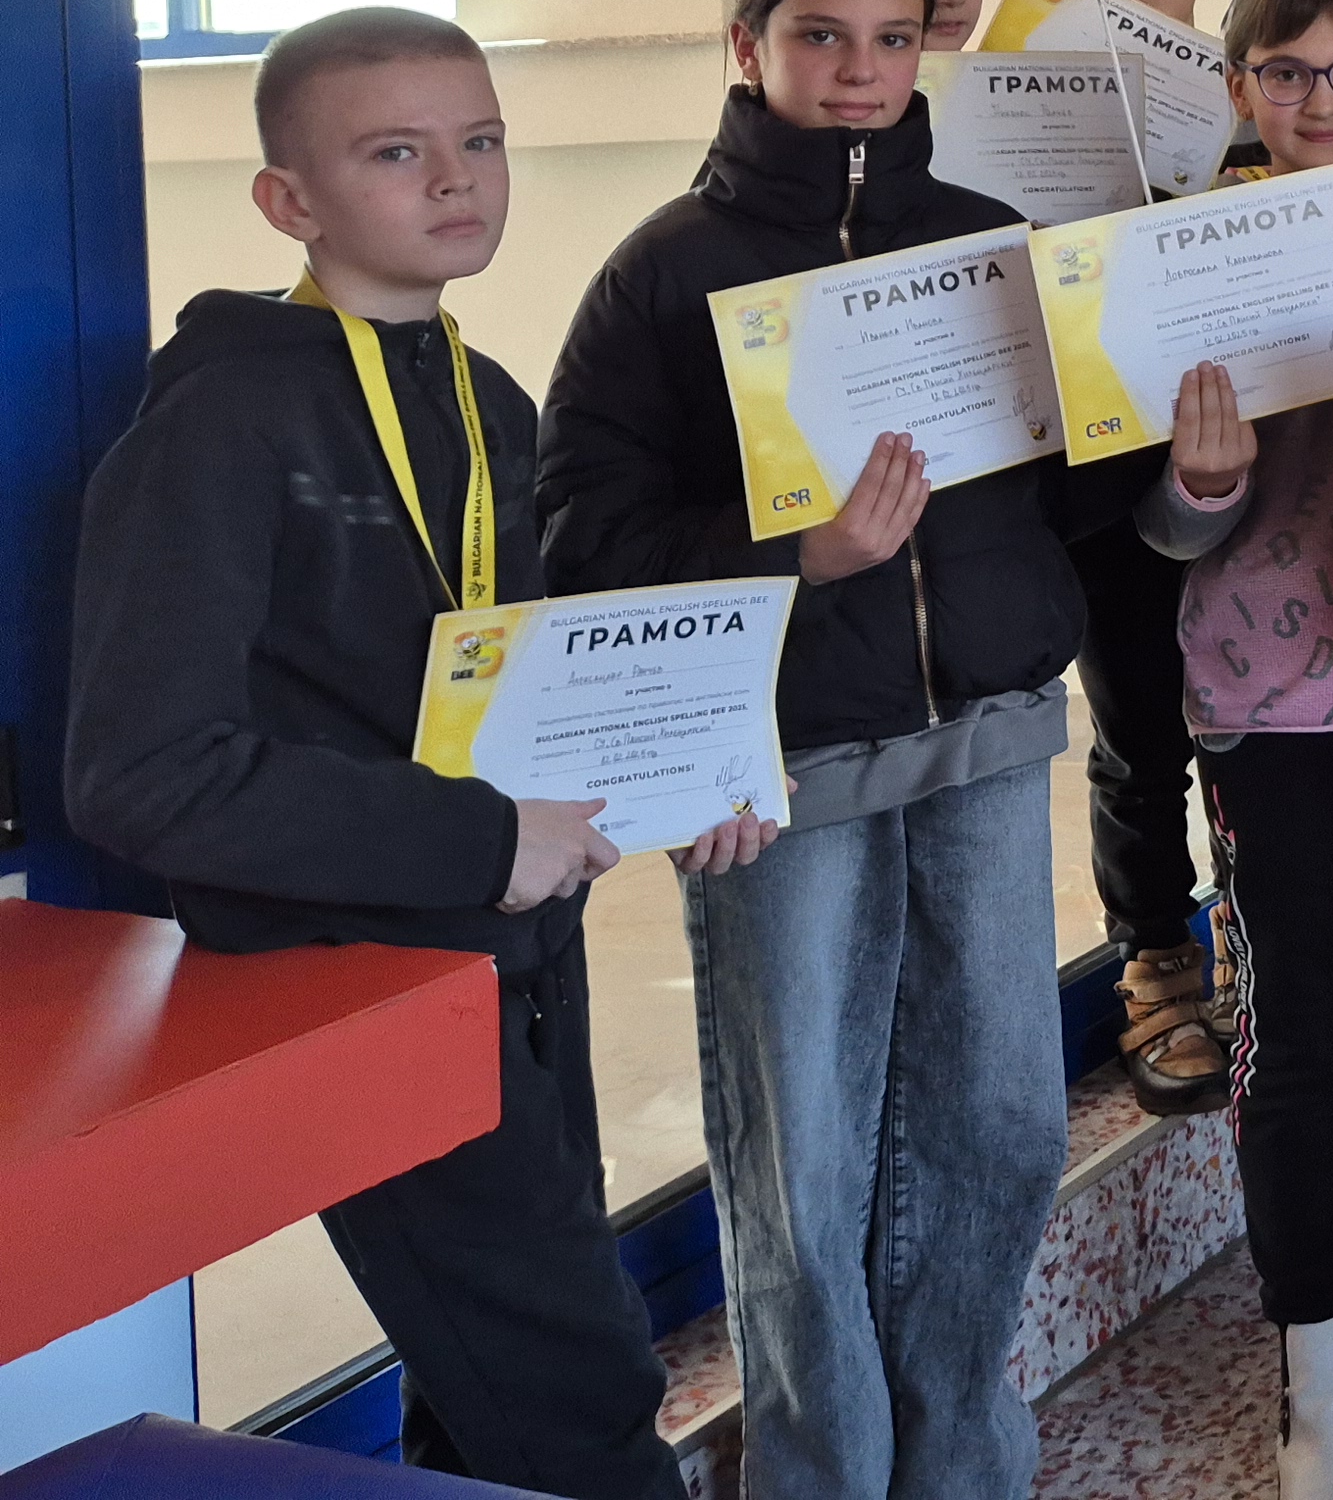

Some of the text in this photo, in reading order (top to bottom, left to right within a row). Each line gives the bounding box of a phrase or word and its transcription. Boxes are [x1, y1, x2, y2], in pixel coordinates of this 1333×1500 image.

[1107, 10, 1224, 76] ГРАМОТА
[989, 76, 1119, 93] ГРАМОТА
[1136, 217, 1186, 234] BULGARIAN
[1188, 206, 1233, 221] NATIONAL
[1156, 199, 1324, 255] ГРАМОТА
[822, 278, 872, 295] BULGARIAN
[874, 268, 917, 283] NATIONAL
[919, 258, 956, 273] ENGLISH
[843, 261, 1005, 316] ГРАМОТА
[1156, 314, 1200, 330] BULGARIAN
[1202, 304, 1240, 319] NATIONAL
[1242, 296, 1275, 309] ENGLISH
[1277, 287, 1313, 300] SPELLING
[1213, 333, 1310, 363] CONGRATULATIONS!
[892, 369, 929, 384] NATIONAL
[931, 360, 961, 374] ENGLISH
[963, 351, 997, 364] SPELLING
[905, 398, 996, 430] CONGRATULATIONS!
[473, 514, 482, 577] BULGARIAN
[550, 595, 769, 628] BULGARIAN NATIONAL ENGLISH SPELLING BEE
[566, 611, 745, 654] ГРАМОТА
[450, 668, 475, 682] BEE
[536, 706, 726, 744] BULGARIAN NATIONAL ENGLISH SPELLING BEE
[586, 764, 695, 789] CONGRATULATIONS!
